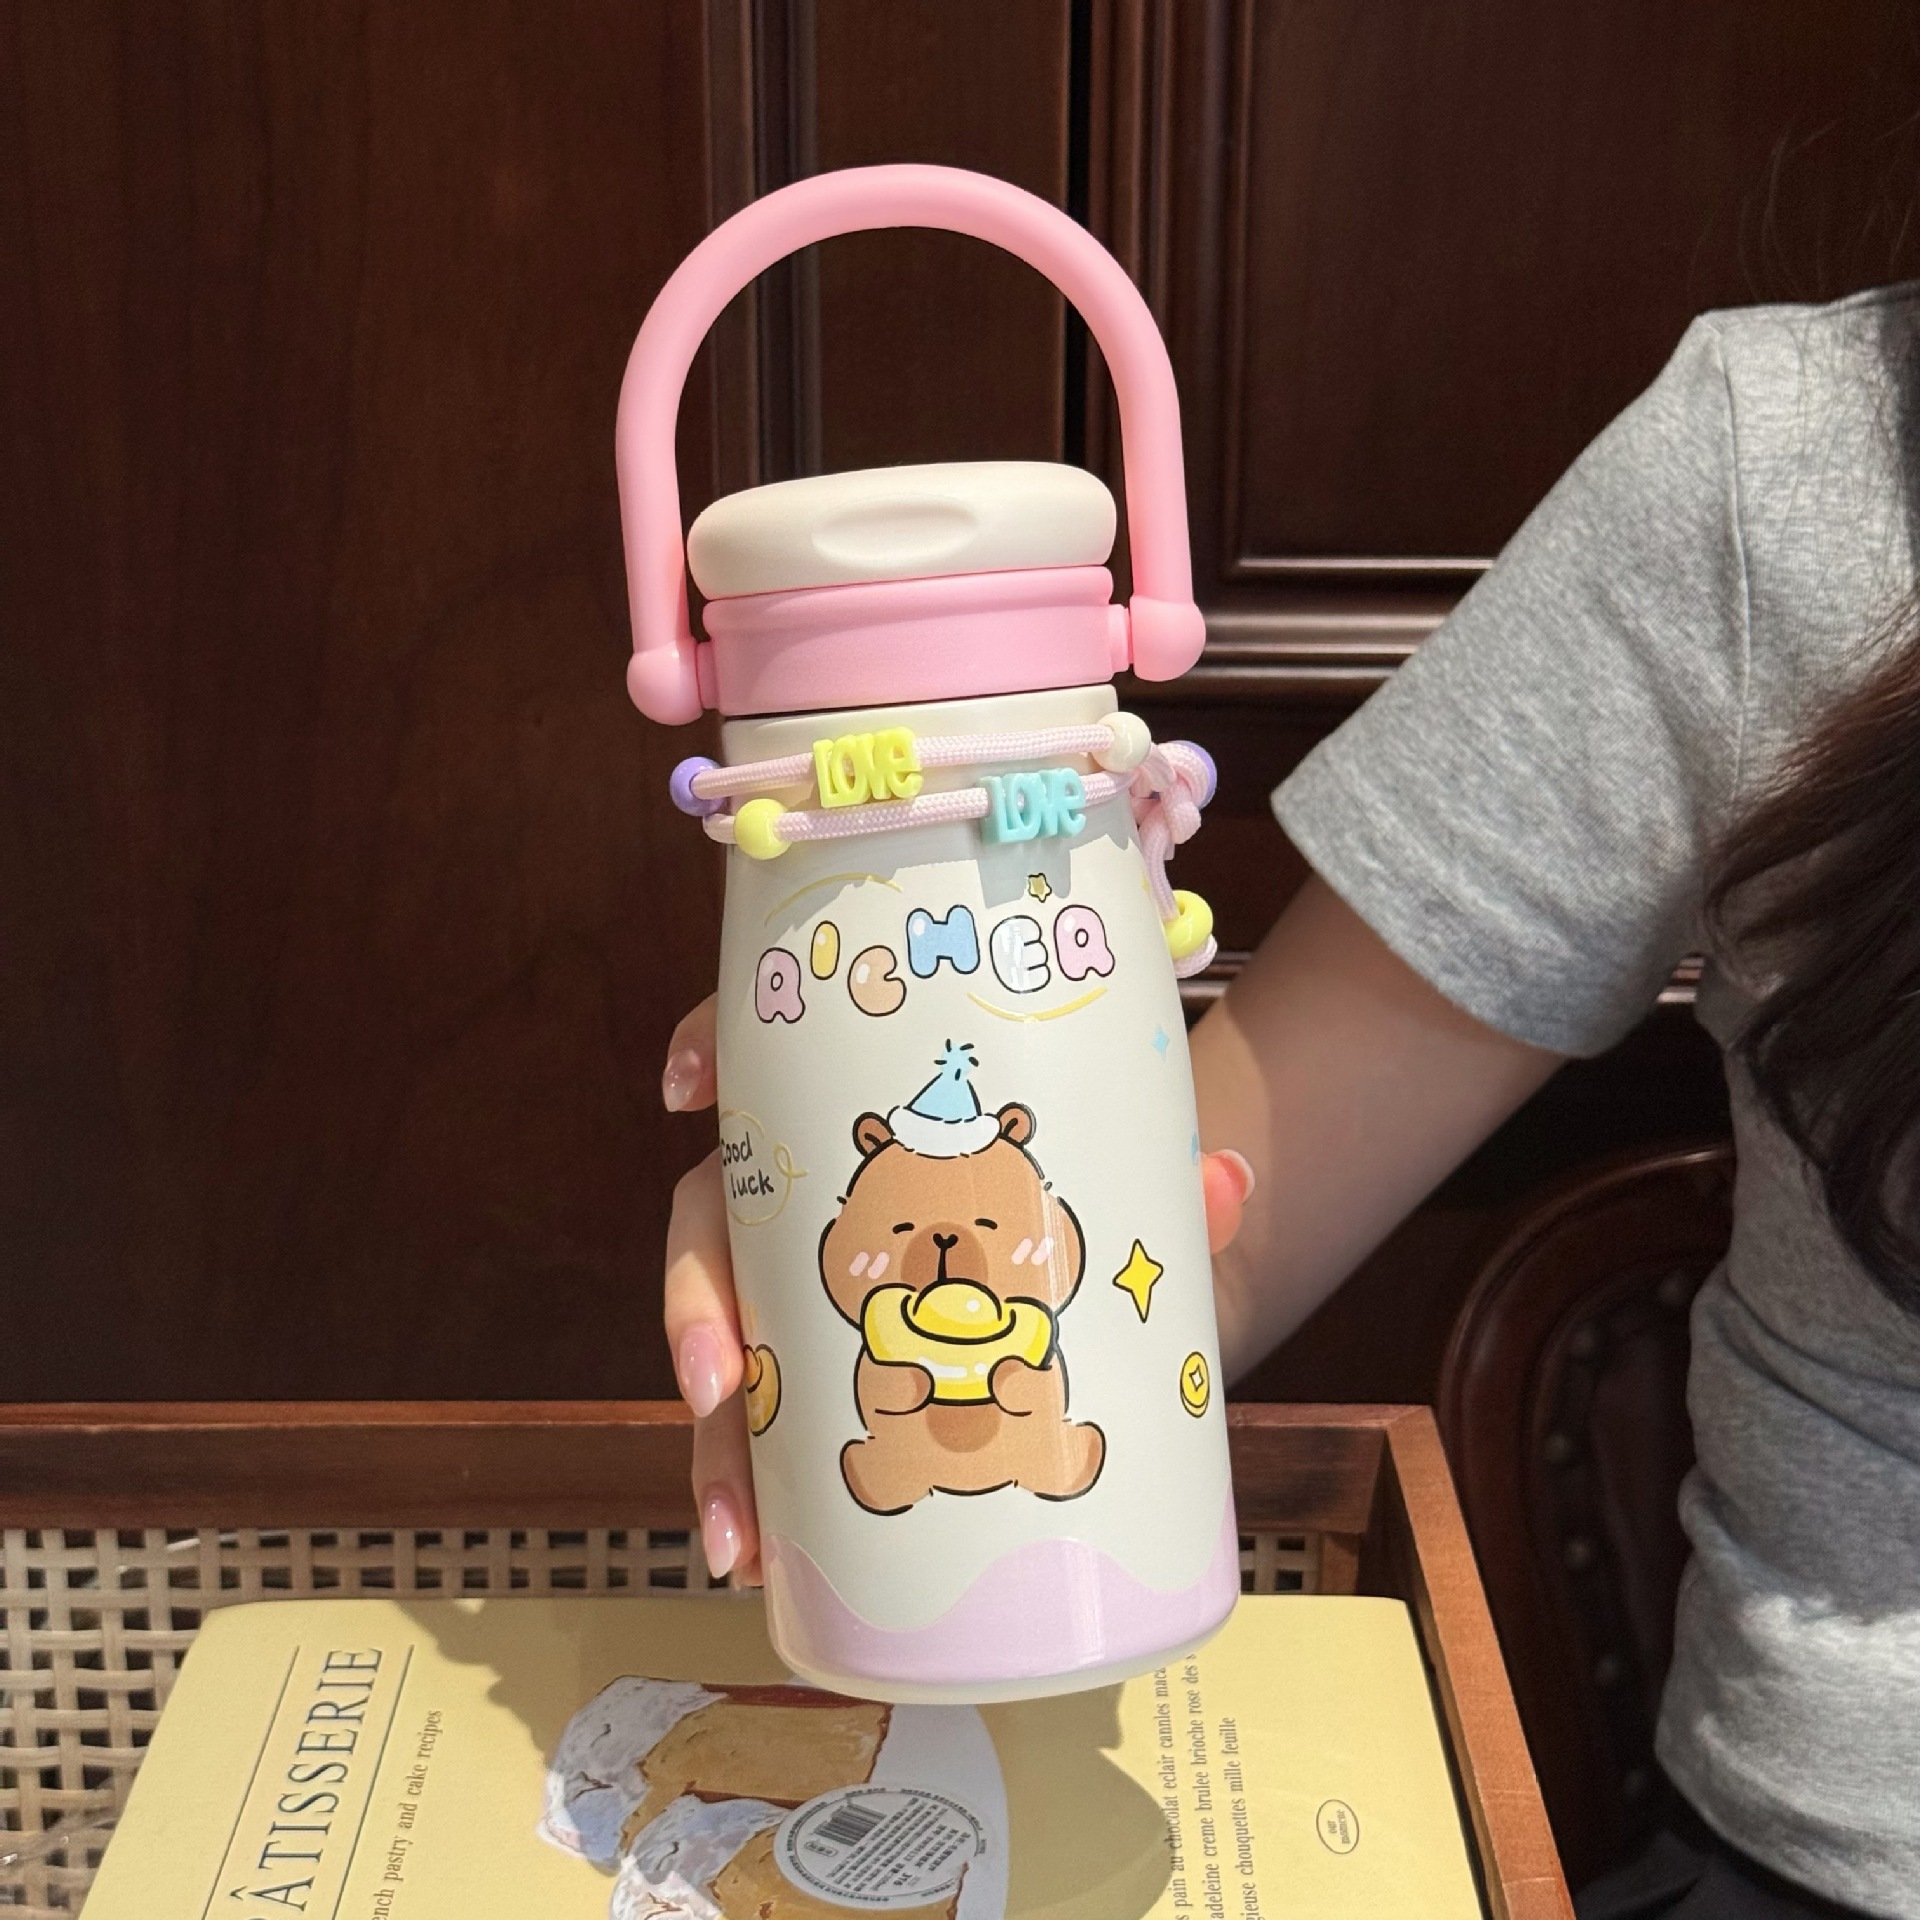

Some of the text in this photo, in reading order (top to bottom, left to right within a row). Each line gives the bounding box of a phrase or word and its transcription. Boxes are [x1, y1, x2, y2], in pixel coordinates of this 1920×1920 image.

[755, 904, 1115, 1024] AICHEA
[730, 1168, 775, 1199] luck
[1181, 1665, 1198, 1684] des
[1187, 1689, 1202, 1714] rose
[417, 1710, 444, 1759] recipes
[1187, 1719, 1208, 1765] brioche
[1219, 1717, 1239, 1754] feuille
[229, 1648, 382, 1920] ÂTISSERIE
[404, 1763, 428, 1796] cake
[1157, 1754, 1177, 1789] eclair
[1224, 1761, 1244, 1792] mille
[1192, 1771, 1212, 1811] brulee
[397, 1802, 418, 1829] and
[1161, 1795, 1182, 1849] chocolat
[1200, 1817, 1217, 1857] creme
[1231, 1798, 1255, 1875] chouquettes
[383, 1834, 413, 1882] pastry
[1170, 1856, 1184, 1871] au
[1167, 1878, 1193, 1907] pain
